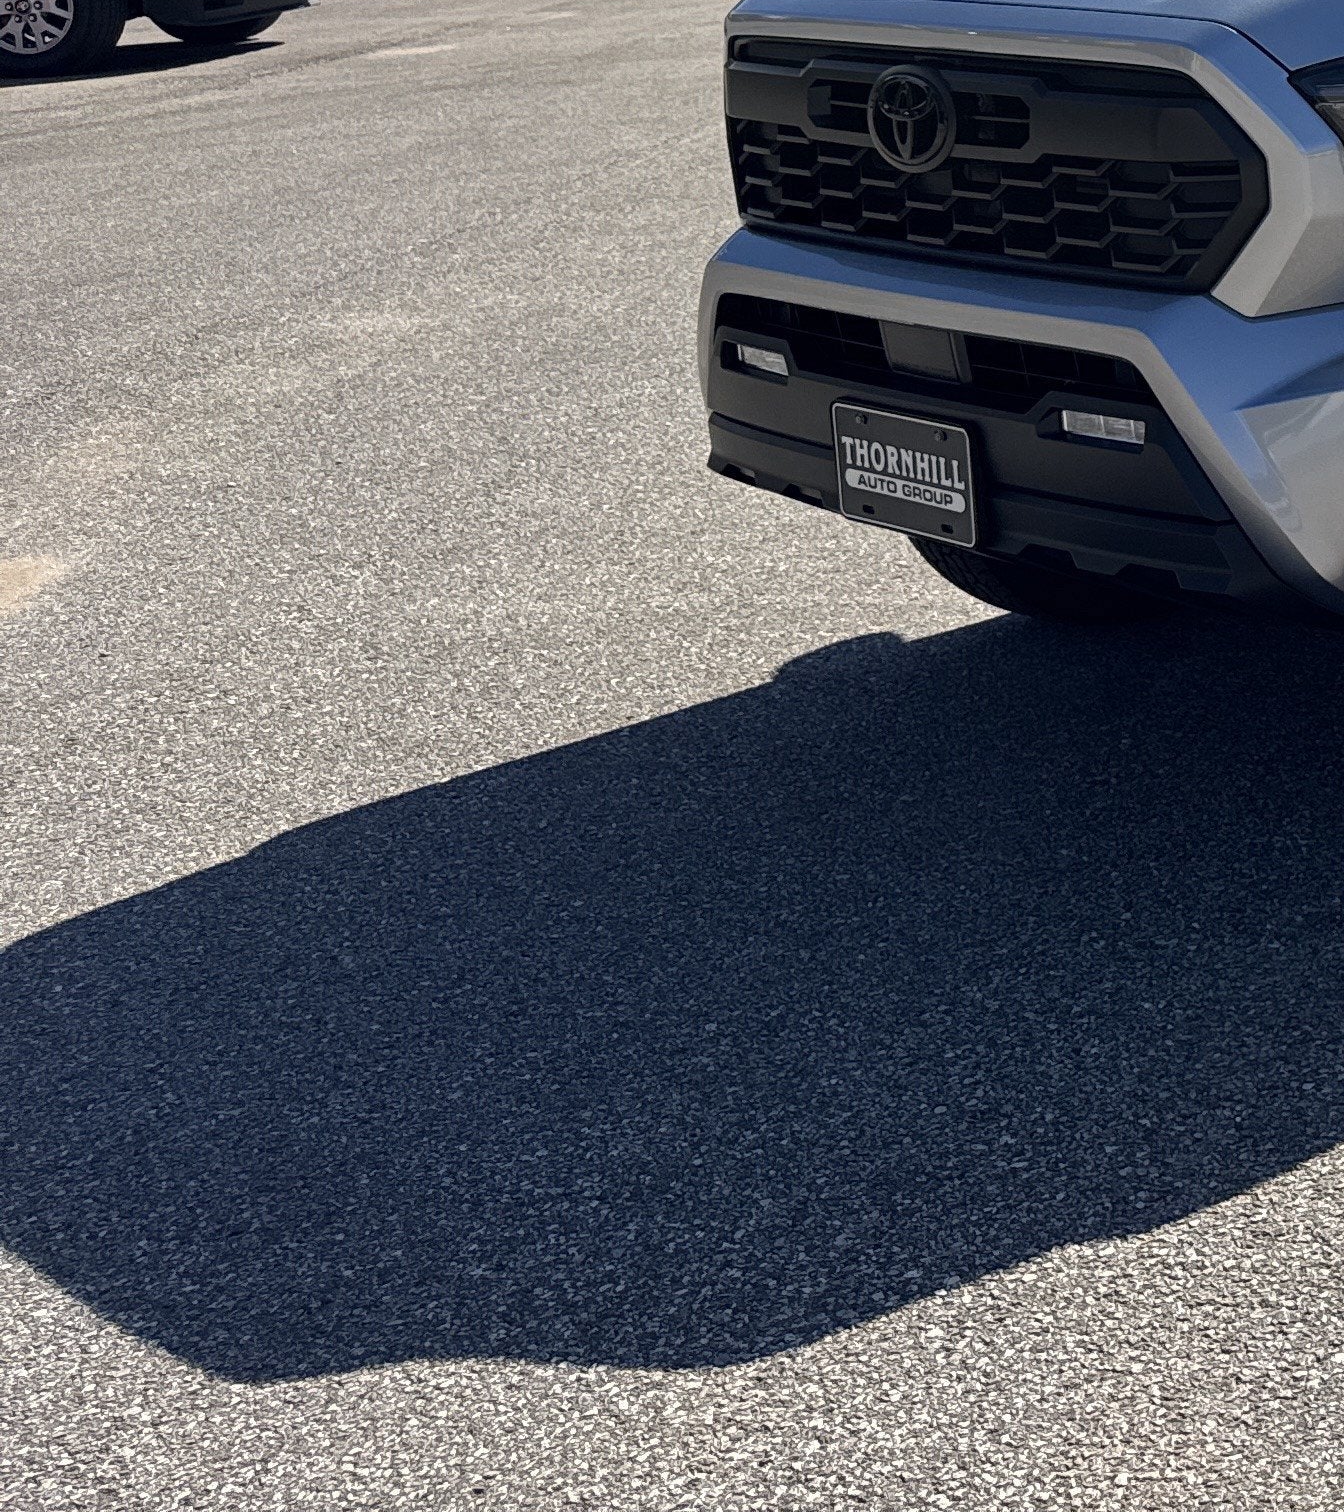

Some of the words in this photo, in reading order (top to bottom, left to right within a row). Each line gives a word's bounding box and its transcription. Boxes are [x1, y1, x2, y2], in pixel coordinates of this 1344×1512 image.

[841, 435, 965, 490] THORNHILL
[857, 473, 897, 494] AUTO
[901, 483, 953, 506] GROUP
